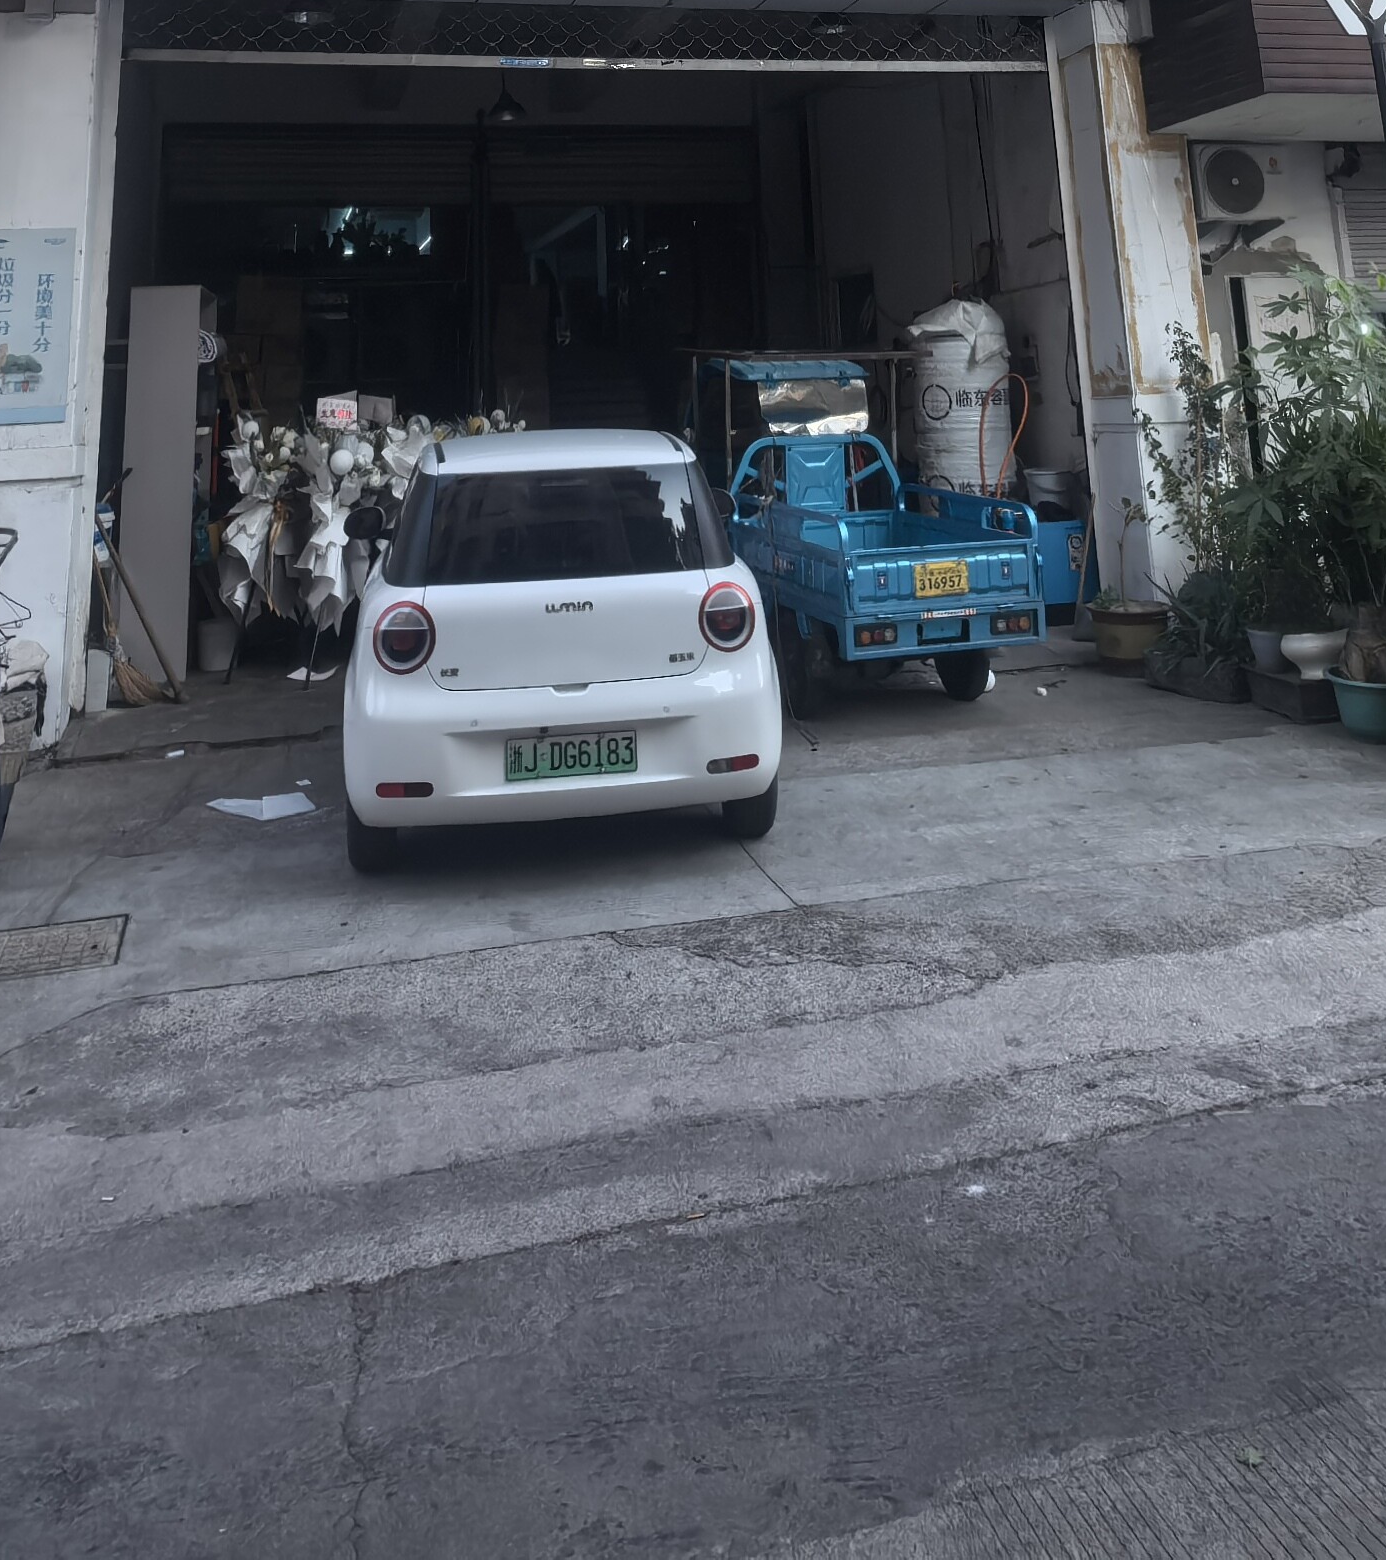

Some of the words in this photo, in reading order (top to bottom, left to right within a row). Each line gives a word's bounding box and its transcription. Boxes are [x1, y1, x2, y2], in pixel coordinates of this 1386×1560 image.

[32, 273, 56, 353] 环境美十分
[919, 574, 962, 592] 316957
